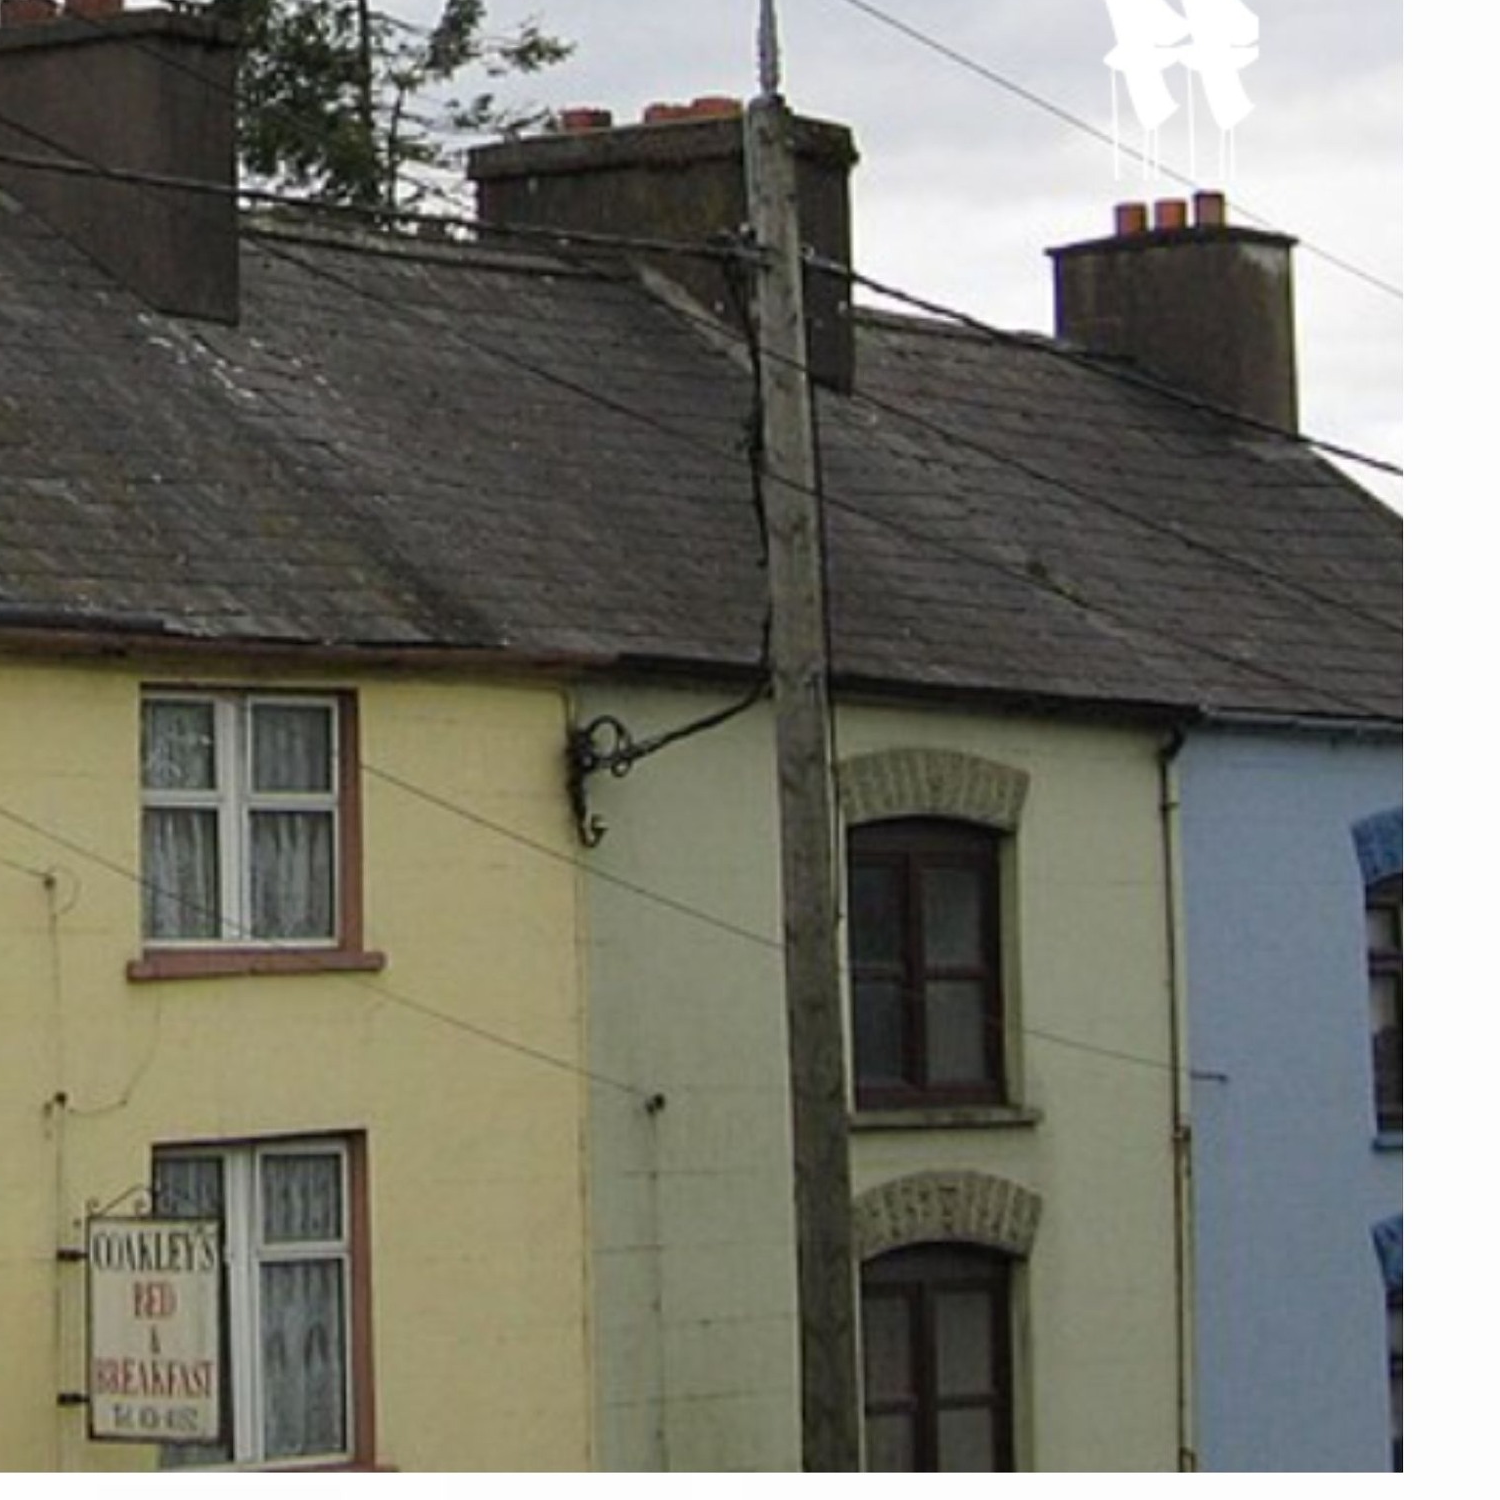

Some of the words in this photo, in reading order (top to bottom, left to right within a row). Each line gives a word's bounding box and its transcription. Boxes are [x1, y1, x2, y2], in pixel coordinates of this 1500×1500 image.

[92, 1226, 215, 1272] COAKLEY'S
[134, 1281, 178, 1318] BED
[93, 1357, 214, 1399] BREAKFAST
